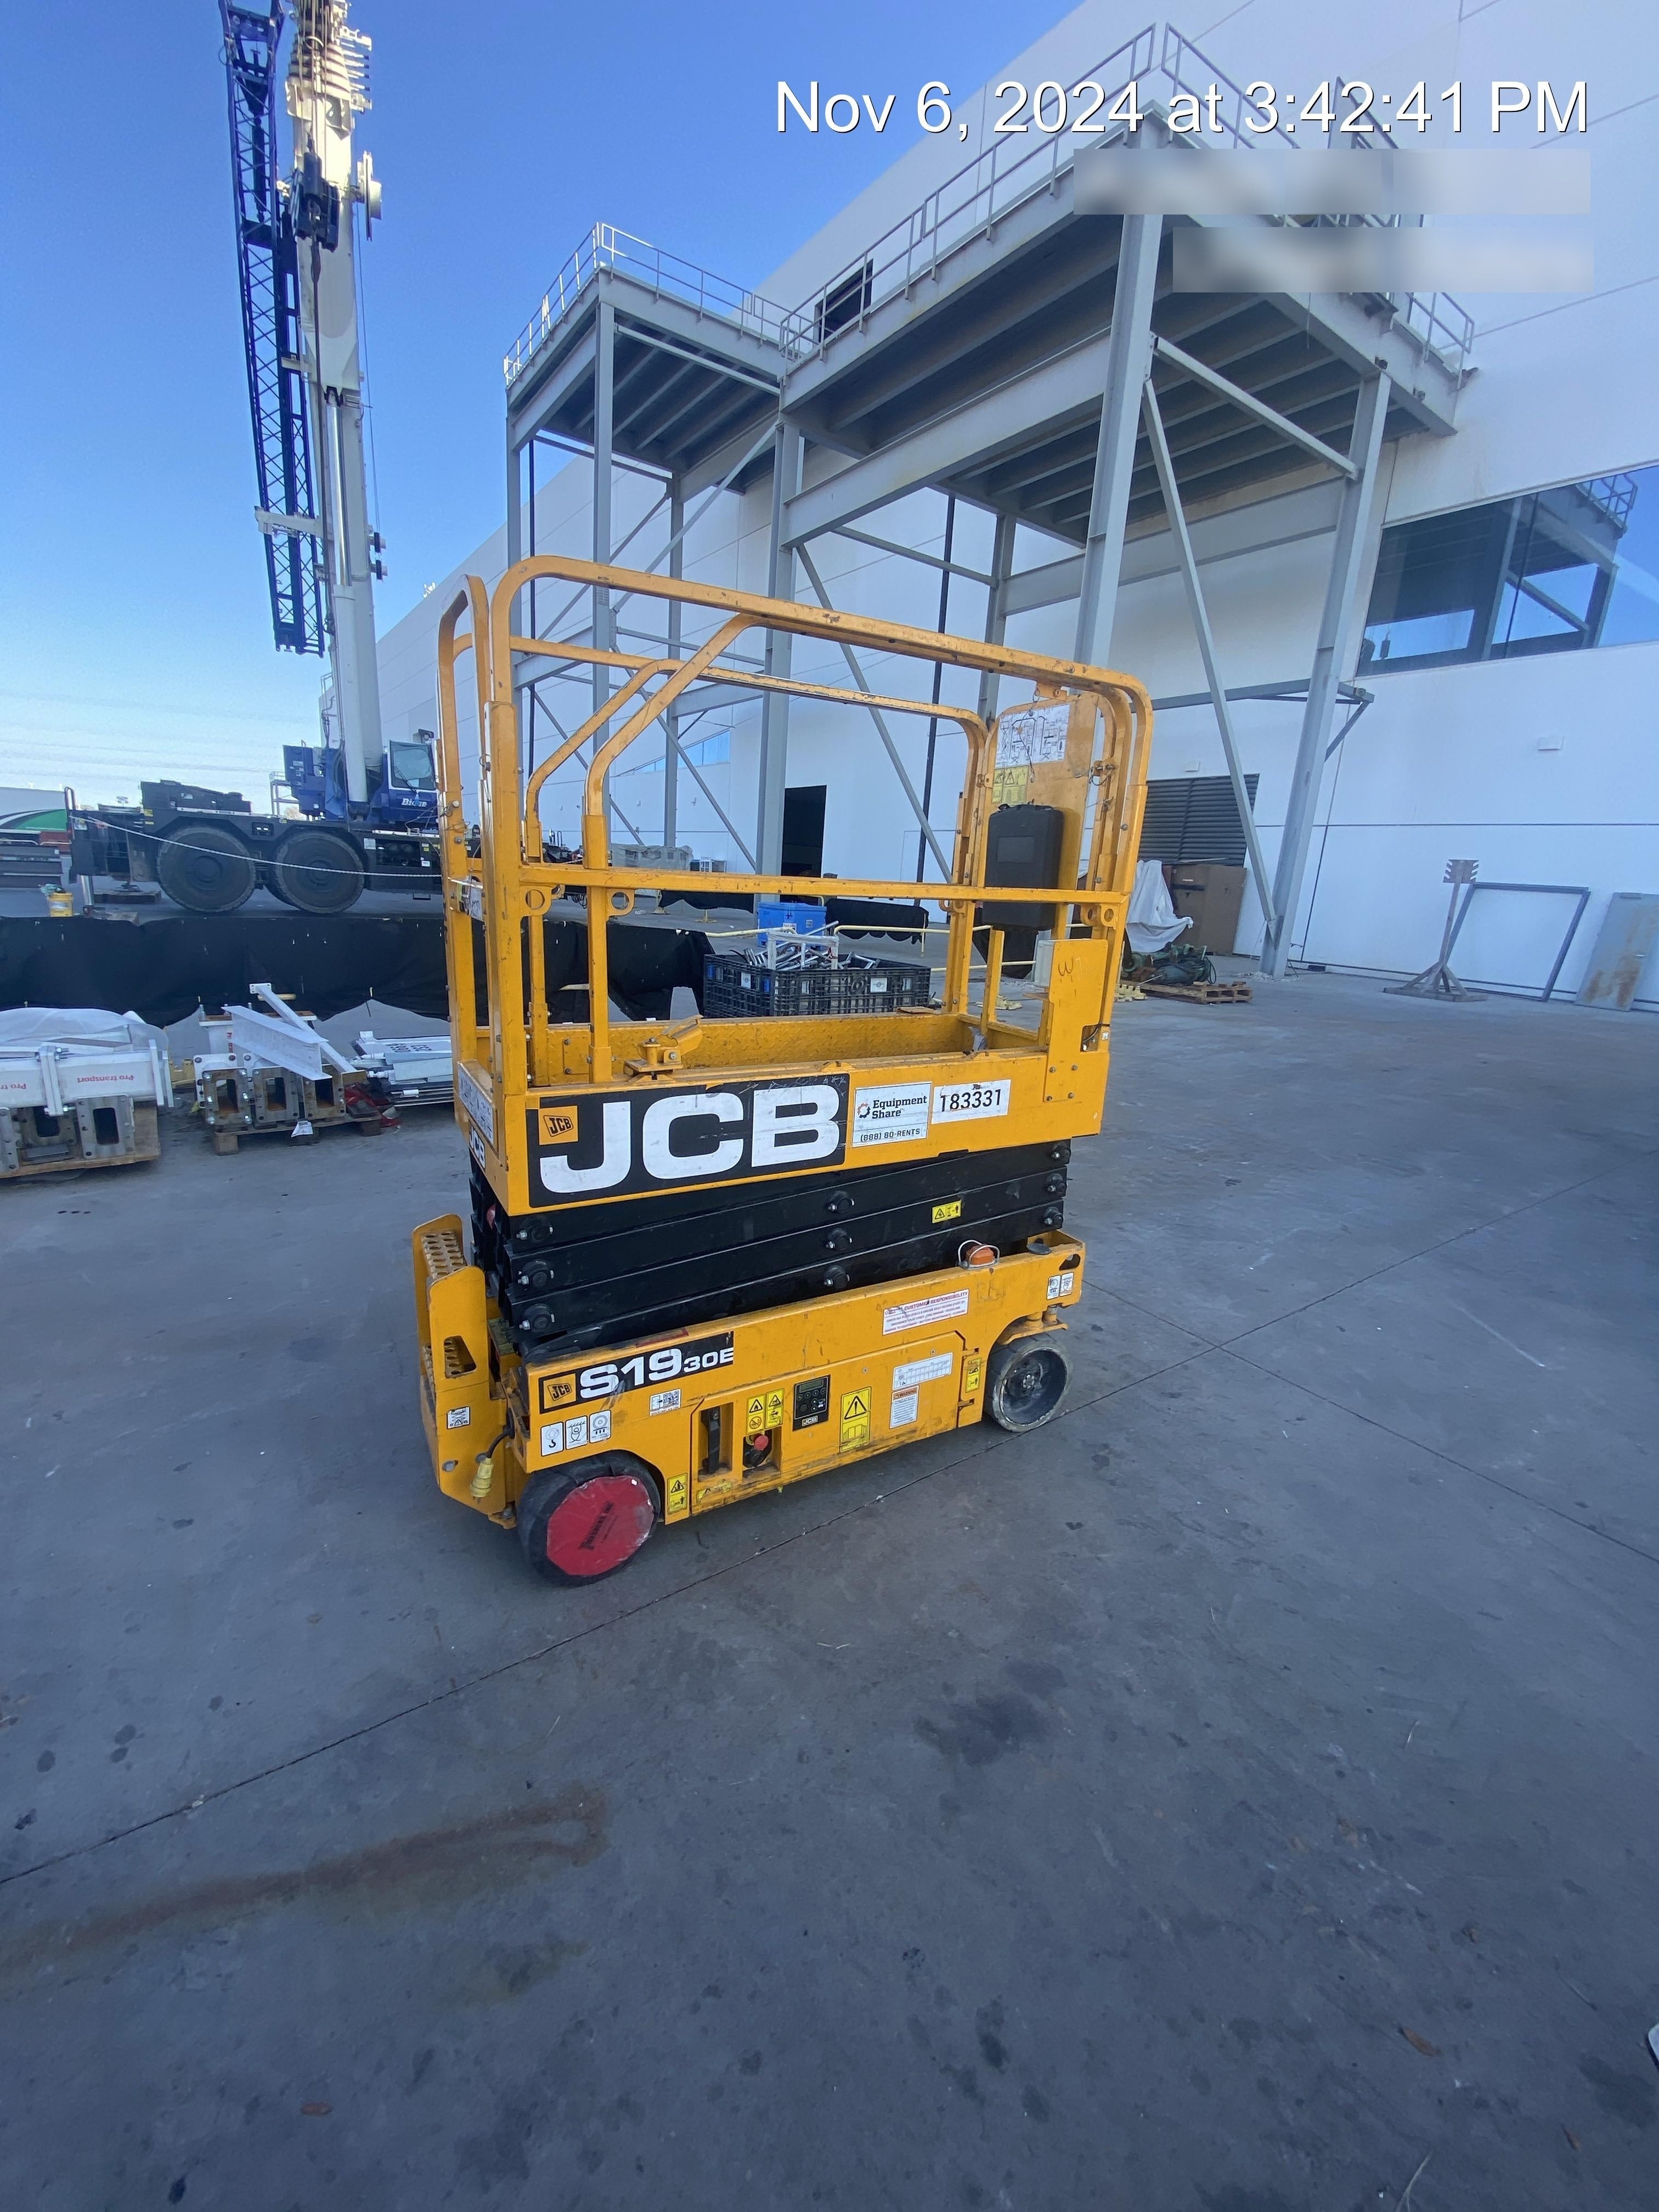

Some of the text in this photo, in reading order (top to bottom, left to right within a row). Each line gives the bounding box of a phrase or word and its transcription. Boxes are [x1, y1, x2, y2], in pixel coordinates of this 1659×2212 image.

[76, 1075, 117, 1084] transport
[872, 1096, 927, 1110] Equipment
[940, 1088, 1001, 1112] 183331
[872, 1109, 901, 1119] Share
[549, 1118, 572, 1135] JCB
[539, 1084, 840, 1193] JCB
[860, 1128, 921, 1142] (888) 80-RENTS
[469, 1125, 486, 1169] JCB
[551, 1383, 571, 1399] JCB
